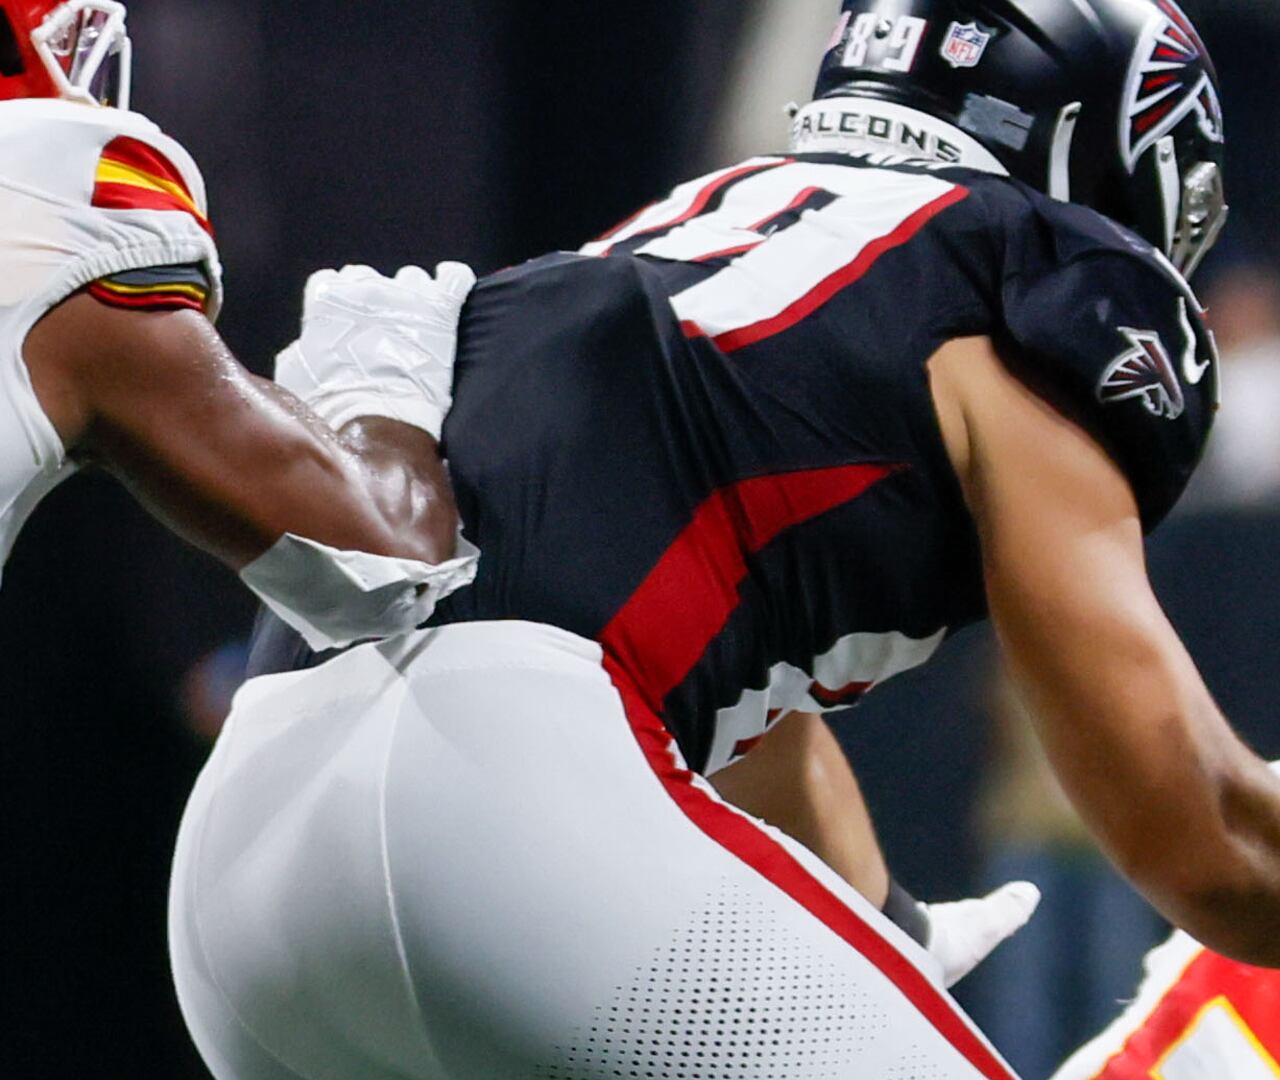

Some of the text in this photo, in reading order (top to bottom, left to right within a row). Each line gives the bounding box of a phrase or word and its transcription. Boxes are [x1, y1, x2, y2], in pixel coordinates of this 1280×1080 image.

[842, 12, 929, 74] 89
[948, 39, 977, 63] NFL
[798, 111, 963, 163] ALCONS
